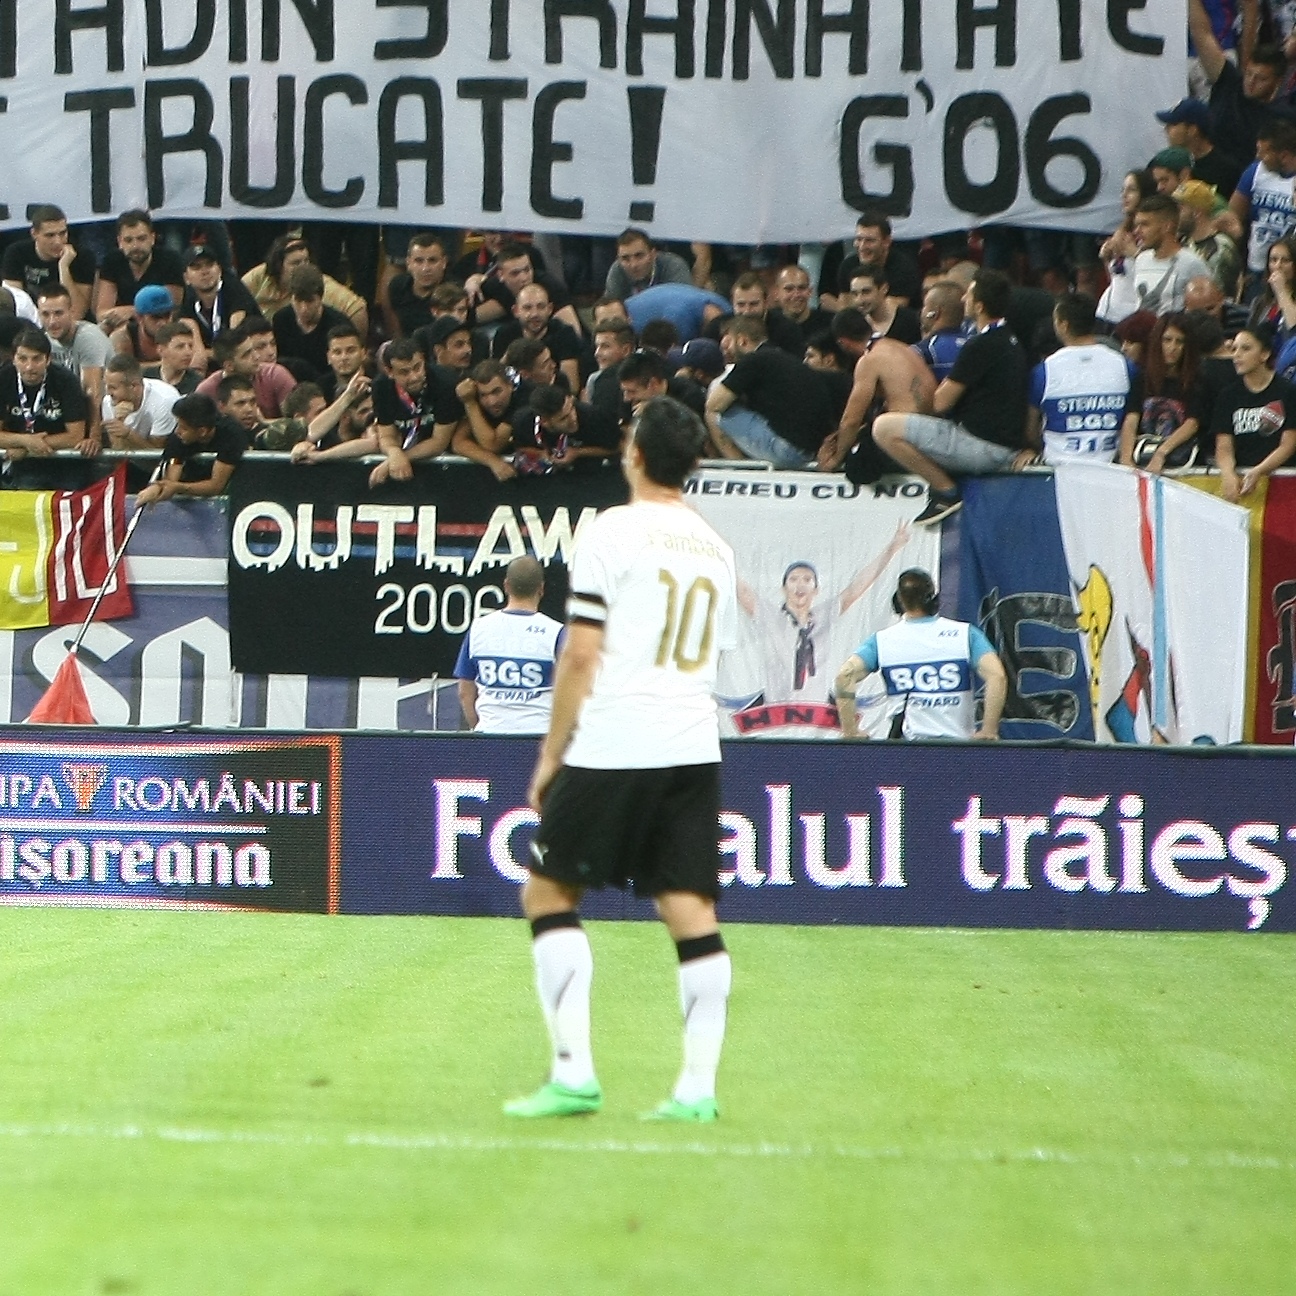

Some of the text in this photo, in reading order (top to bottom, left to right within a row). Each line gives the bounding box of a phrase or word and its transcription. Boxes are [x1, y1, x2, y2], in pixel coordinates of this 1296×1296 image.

[1057, 395, 1126, 414] STEWARD
[1065, 414, 1118, 431] BGS
[811, 483, 860, 502] CU
[653, 566, 719, 674] 10
[477, 659, 545, 688] BGS
[890, 663, 962, 693] BGS
[113, 772, 322, 816] ROMÂNIEI
[430, 777, 909, 889] Foalul
